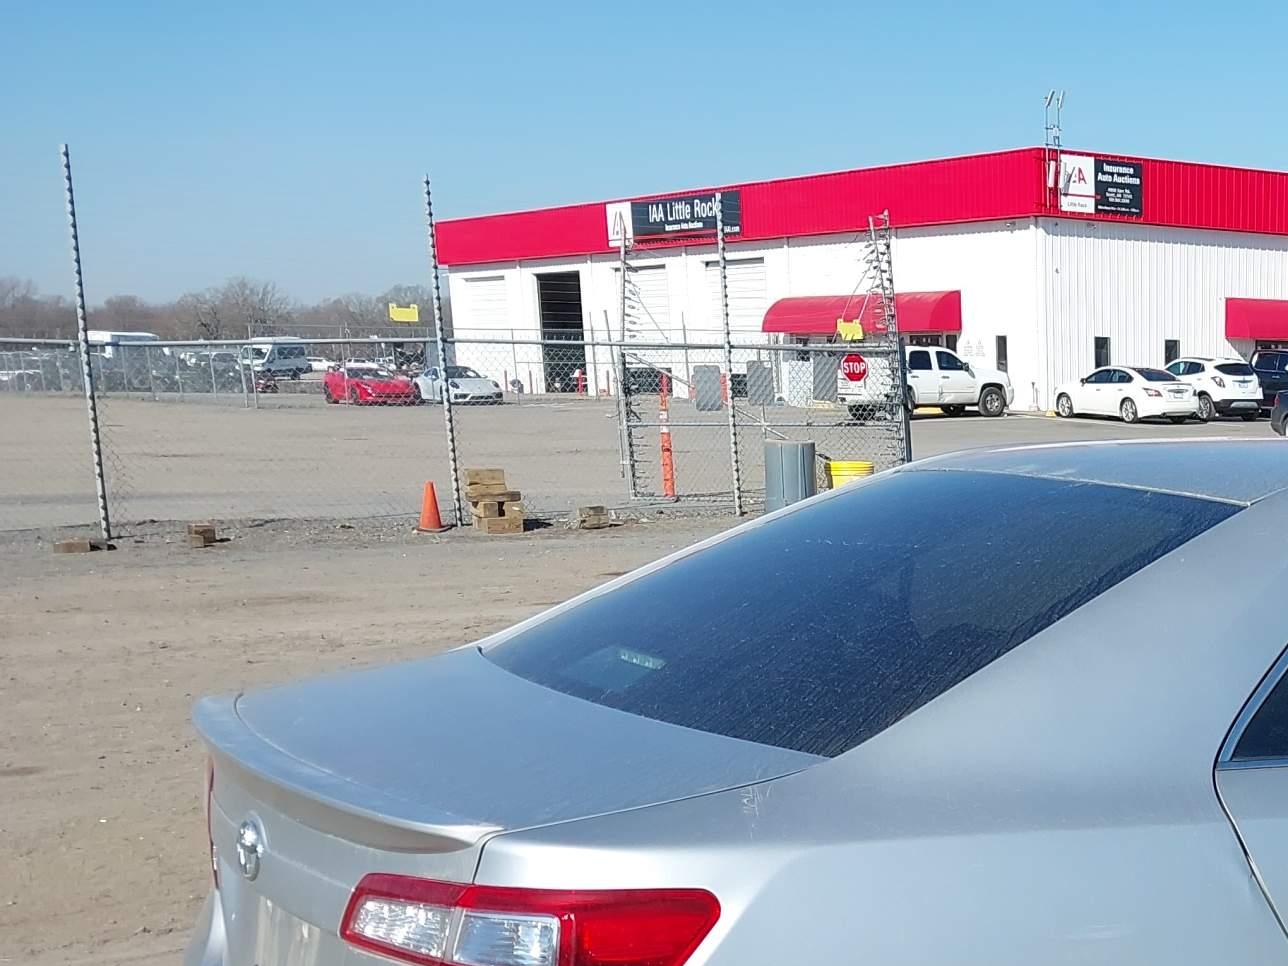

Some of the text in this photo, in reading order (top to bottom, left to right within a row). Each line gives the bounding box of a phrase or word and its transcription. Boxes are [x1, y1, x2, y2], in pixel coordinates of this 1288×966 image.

[1103, 162, 1134, 174] Insurance
[1097, 172, 1140, 185] Auto Auctions
[648, 197, 718, 222] IAA Little Rock
[843, 362, 866, 374] STOP
